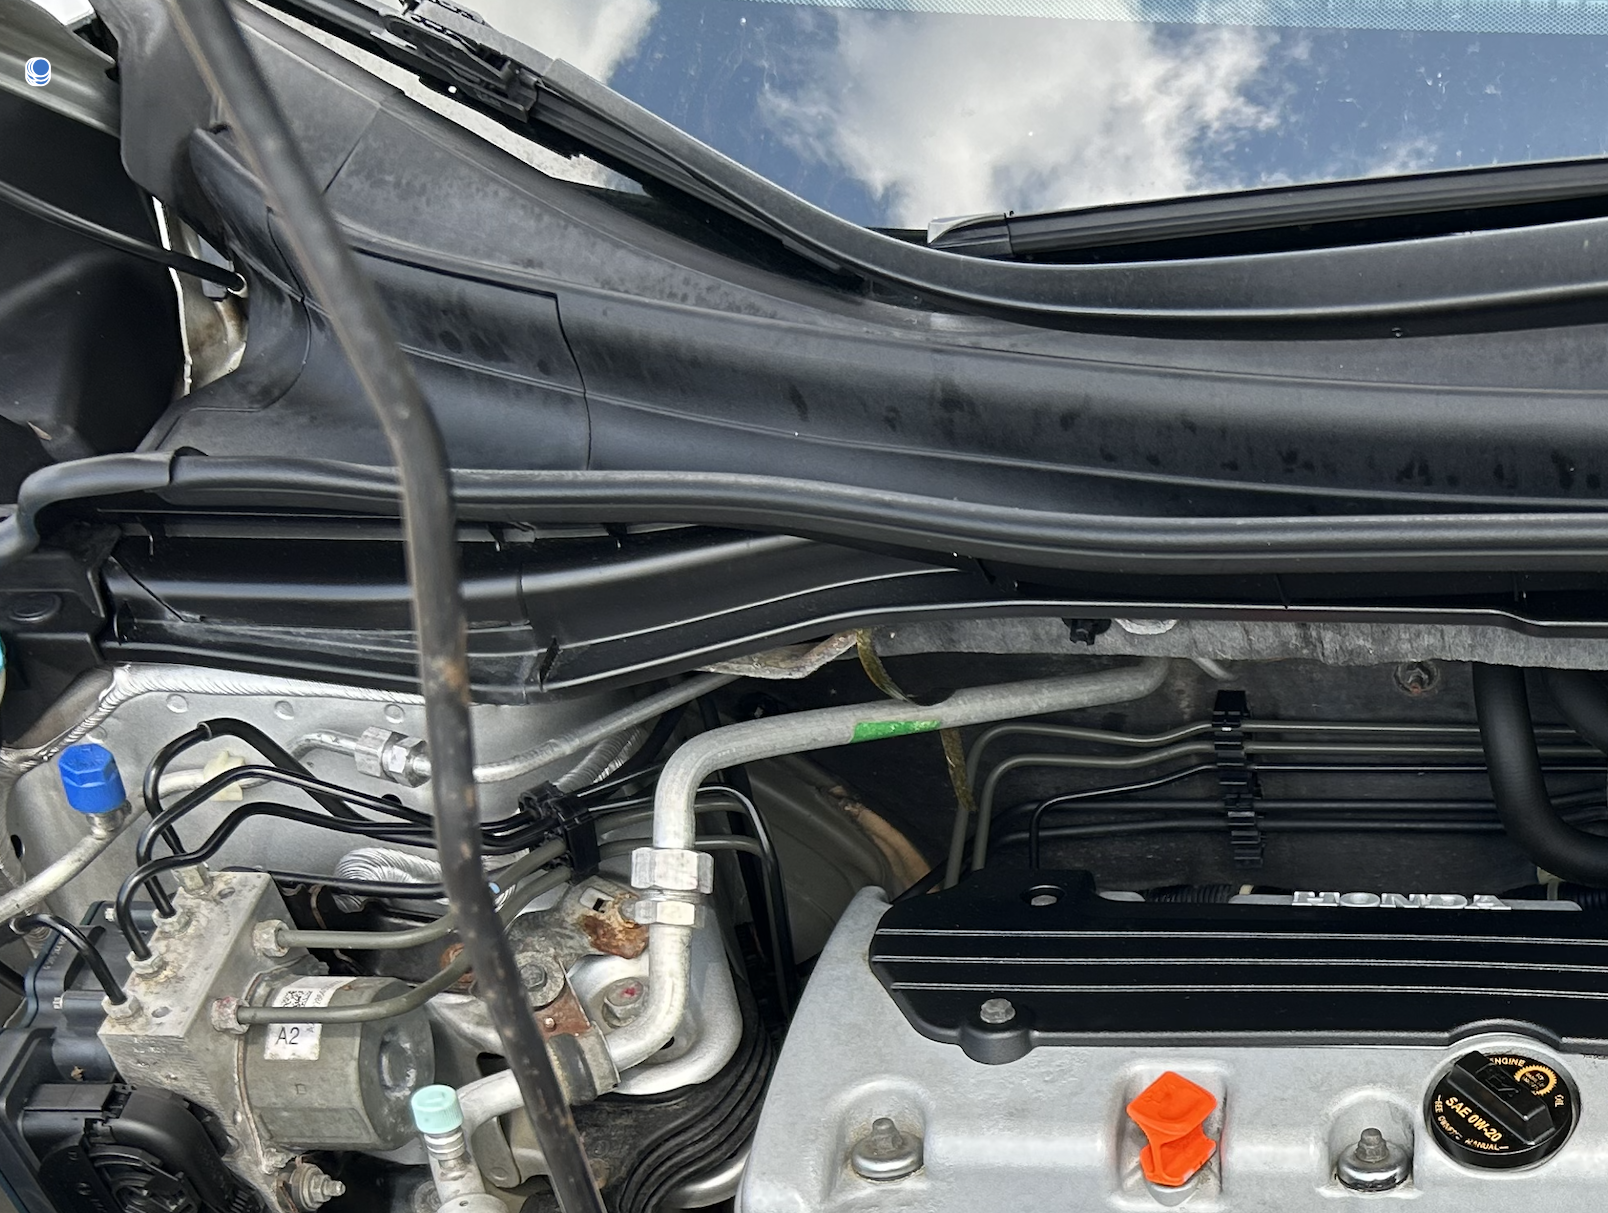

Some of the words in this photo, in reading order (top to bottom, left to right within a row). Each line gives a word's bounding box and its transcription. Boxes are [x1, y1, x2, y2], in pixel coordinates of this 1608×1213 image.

[1291, 890, 1512, 911] HONDA
[275, 1026, 301, 1045] A2
[1445, 1097, 1472, 1118] SAE
[1467, 1114, 1503, 1143] 0W-20
